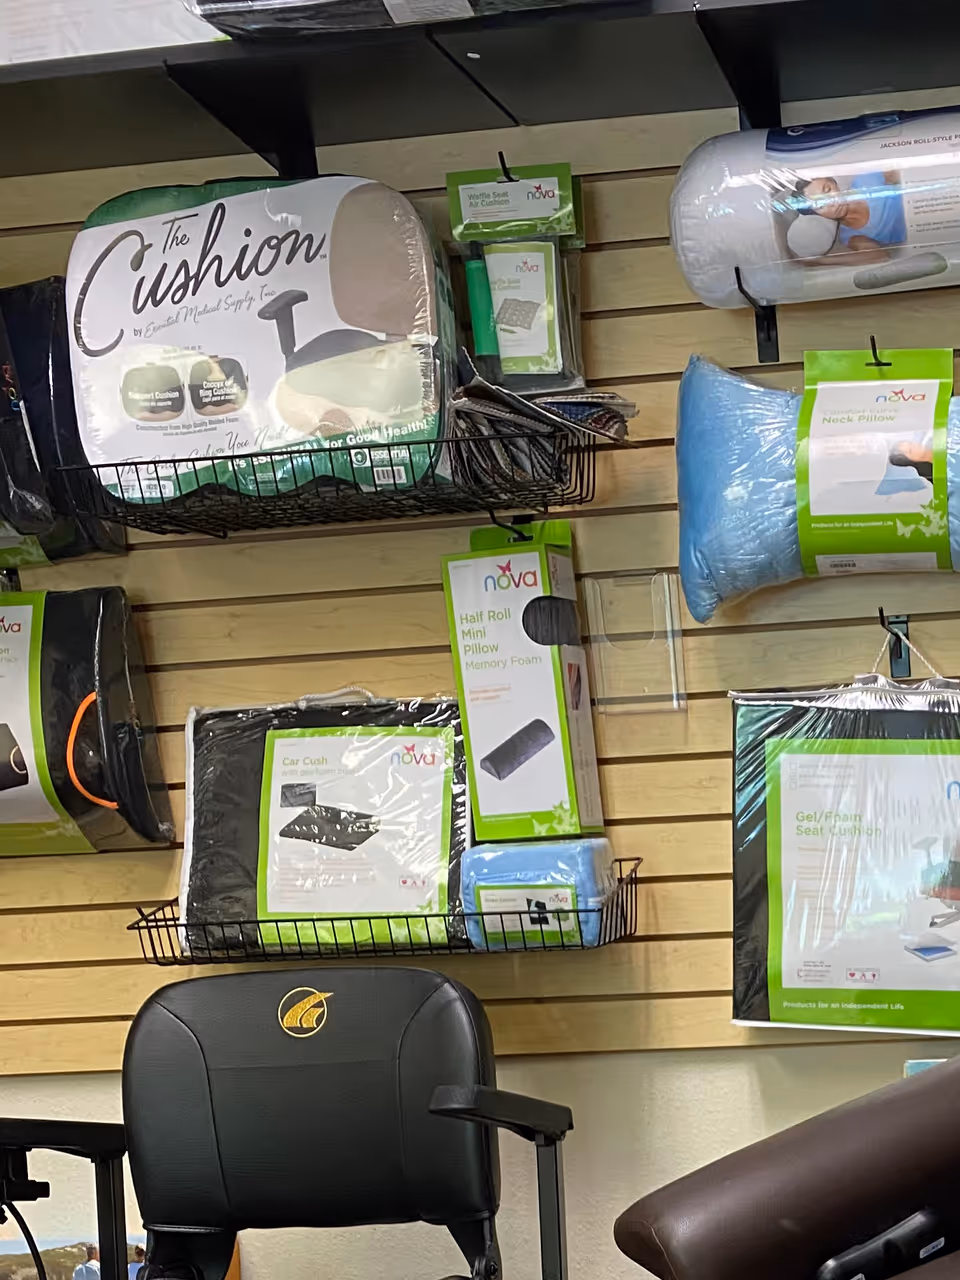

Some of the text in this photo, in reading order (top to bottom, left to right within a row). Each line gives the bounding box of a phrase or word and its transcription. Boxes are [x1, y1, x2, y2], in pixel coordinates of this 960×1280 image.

[879, 139, 912, 149] JACKSON
[913, 134, 953, 146] ROLL-STYLE
[467, 190, 509, 200] Waffle Seat
[527, 188, 555, 200] nova
[480, 198, 510, 207] Cushion
[161, 213, 199, 254] The
[515, 264, 539, 272] nova
[74, 202, 327, 357] Cushion
[133, 327, 143, 337] by
[179, 304, 221, 323] Medical
[224, 290, 256, 312] Supply,
[155, 391, 180, 399] Cushion
[876, 393, 926, 403] nova
[822, 414, 897, 424] Neck Pillow
[346, 430, 379, 445] Good
[385, 419, 428, 439] Health!
[225, 431, 250, 455] You
[484, 570, 538, 592] nova
[459, 608, 511, 625] Half Roll
[461, 627, 486, 640] Mini
[463, 643, 499, 656] Pillow
[465, 655, 543, 671] Memory Foam
[282, 757, 300, 766] Car
[391, 752, 435, 766] nova
[795, 825, 882, 836] Seat Cushion
[783, 1001, 816, 1009] Products
[818, 1001, 829, 1009] for
[841, 1002, 889, 1010] Independent
